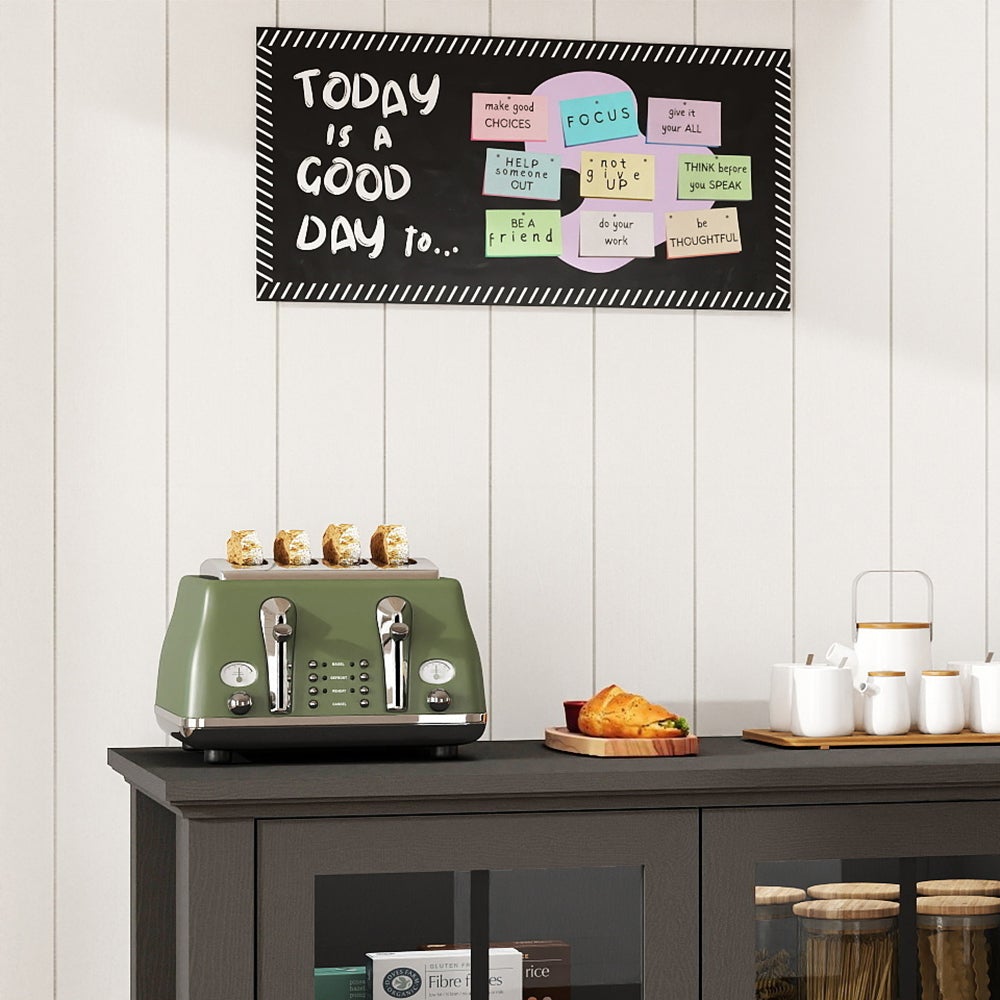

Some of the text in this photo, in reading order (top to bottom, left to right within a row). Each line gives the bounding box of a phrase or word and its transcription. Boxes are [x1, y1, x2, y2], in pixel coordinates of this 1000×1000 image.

[293, 68, 440, 118] TODAY
[485, 100, 534, 115] make good
[668, 108, 696, 118] give it
[485, 118, 531, 129] CHOICES
[567, 107, 630, 128] FOCUS
[662, 124, 702, 134] your ALL
[326, 123, 393, 151] IS A
[505, 157, 539, 169] HELP
[601, 158, 627, 169] not
[684, 162, 748, 175] THINK before
[297, 156, 411, 201] GOOD
[495, 168, 549, 179] someone
[511, 180, 534, 191] OUT
[606, 179, 628, 191] UP
[690, 180, 742, 192] you SPEAK
[511, 218, 536, 228] BE A
[599, 218, 634, 231] do your
[697, 218, 708, 228] be
[296, 214, 386, 259] DAY
[489, 228, 553, 247] friend
[604, 235, 628, 245] work
[669, 232, 738, 248] THOUGHTFUL
[525, 964, 550, 978] rice
[429, 974, 462, 988] Fibre
